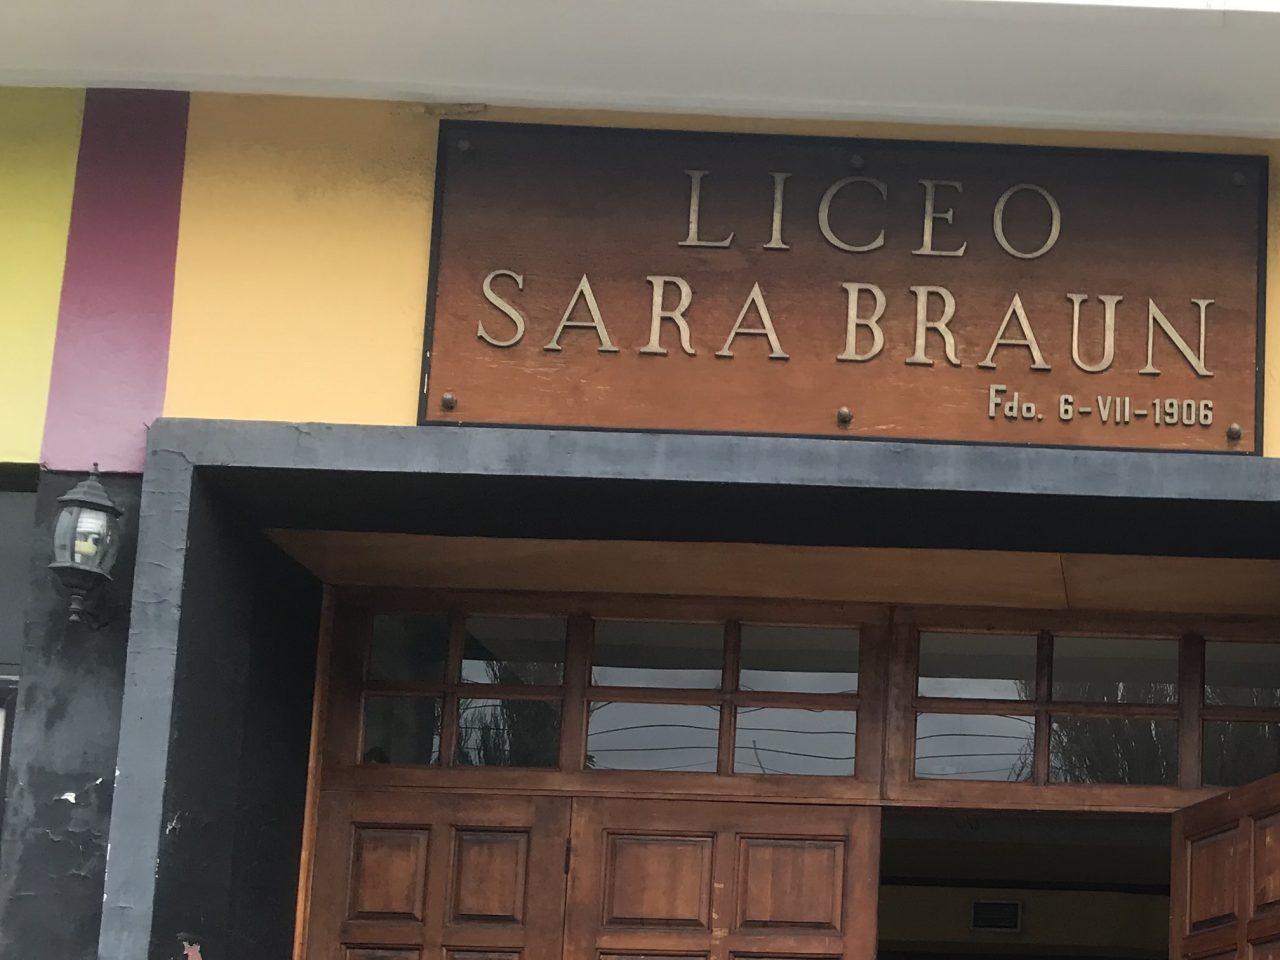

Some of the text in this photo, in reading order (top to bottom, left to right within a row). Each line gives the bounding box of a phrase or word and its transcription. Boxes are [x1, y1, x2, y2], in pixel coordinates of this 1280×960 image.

[677, 168, 1062, 260] LICEO
[475, 268, 1215, 378] SARA BRAUN
[988, 384, 1214, 426] Fdo. 6-VII-1906
